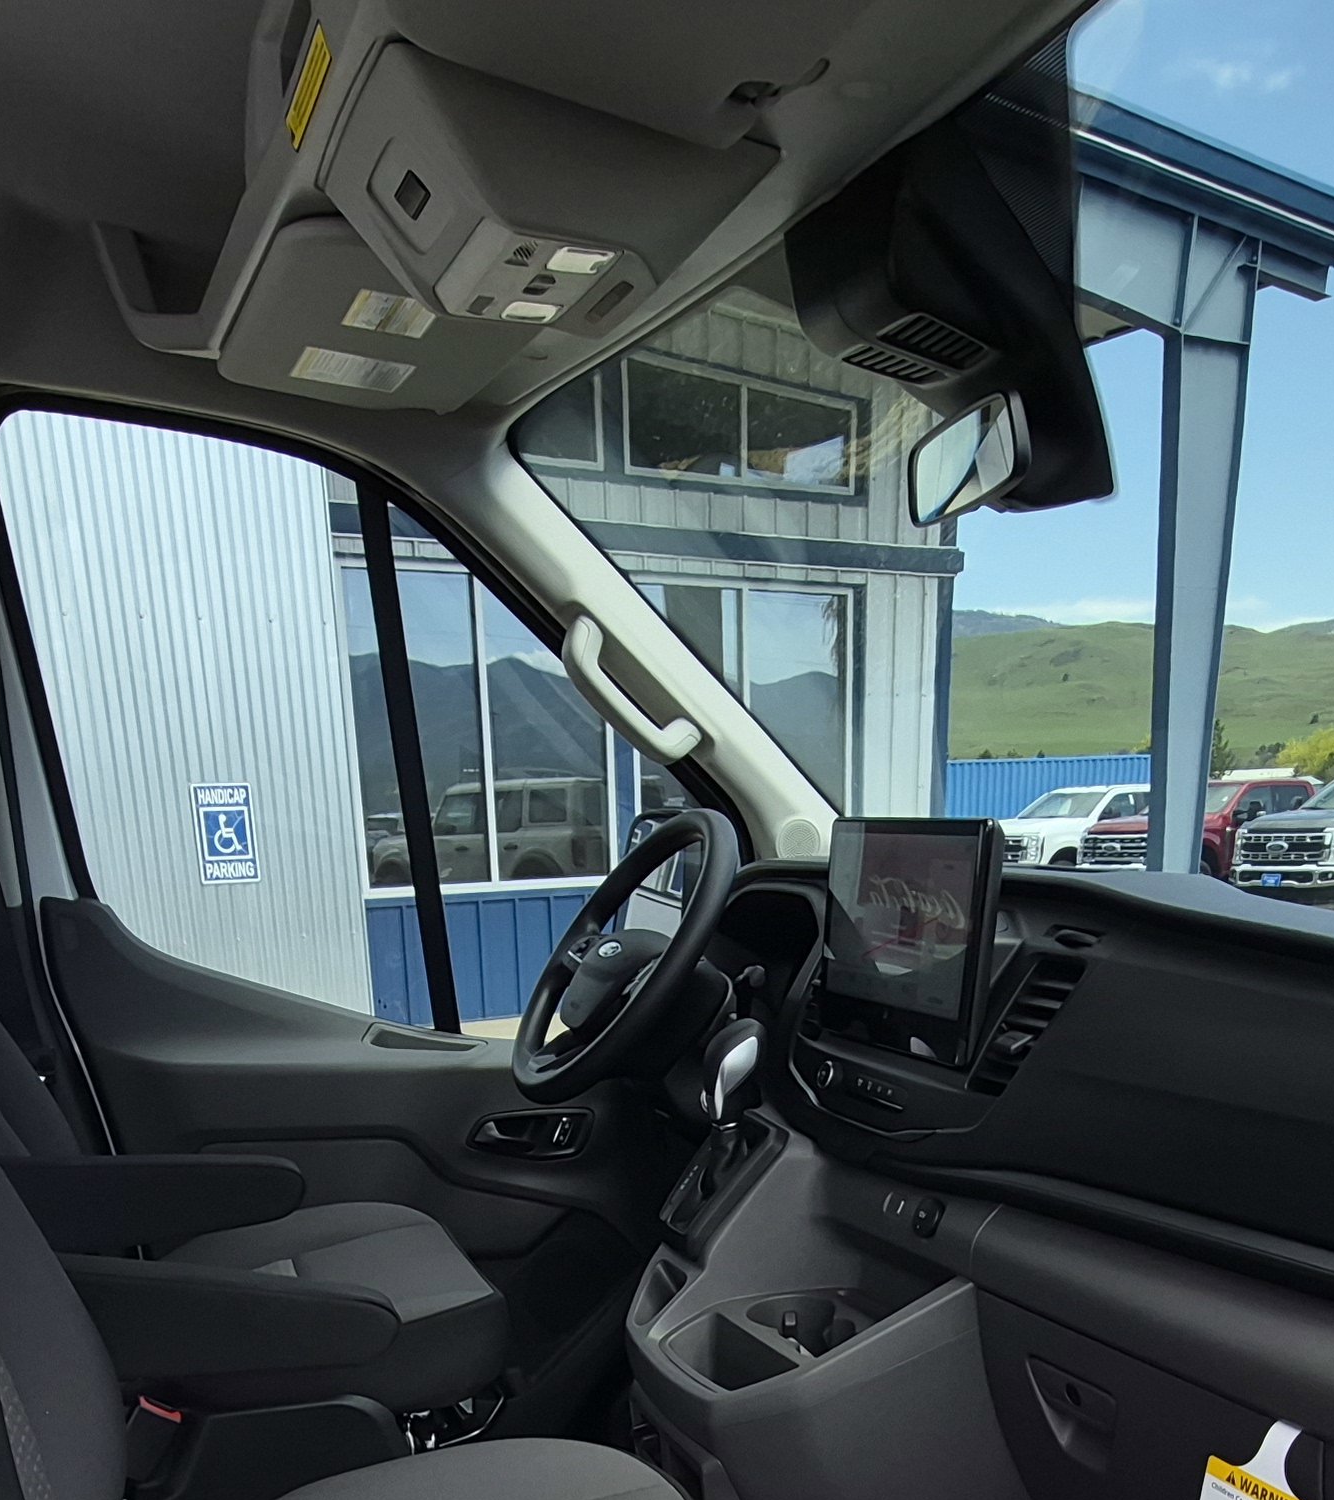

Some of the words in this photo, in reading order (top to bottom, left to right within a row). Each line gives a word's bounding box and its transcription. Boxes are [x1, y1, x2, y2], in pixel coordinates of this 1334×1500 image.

[197, 788, 246, 804] HANDICAP
[205, 861, 255, 879] PARKING
[1211, 1481, 1235, 1499] Children
